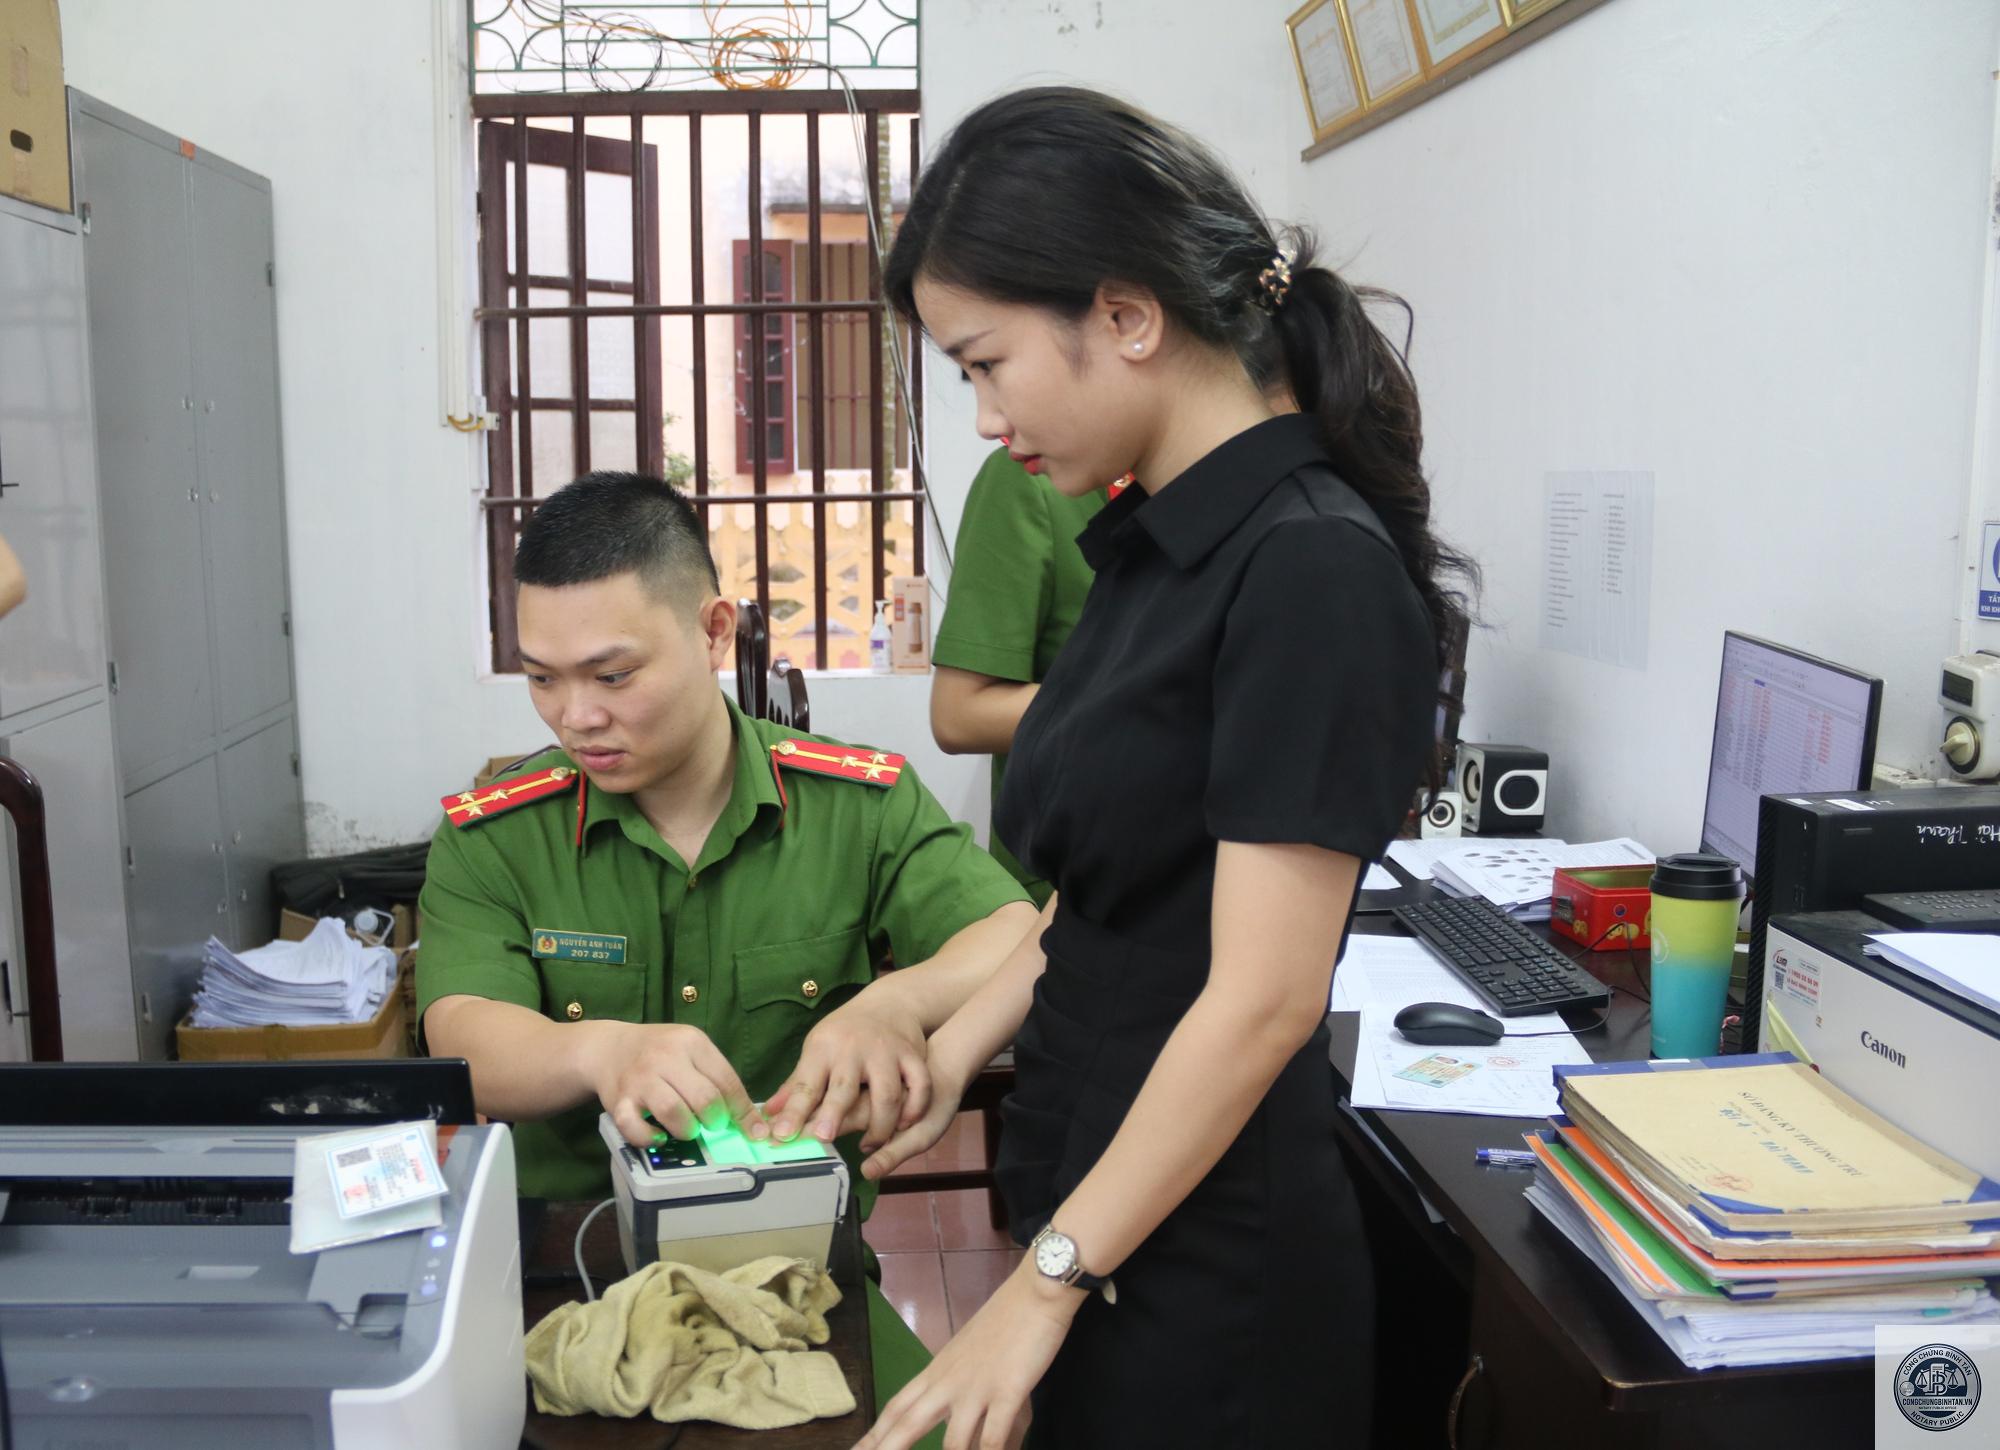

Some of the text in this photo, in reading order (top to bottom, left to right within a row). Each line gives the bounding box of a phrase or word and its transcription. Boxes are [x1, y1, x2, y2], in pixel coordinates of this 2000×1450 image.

[571, 949, 610, 960] 207 837
[1861, 1030, 1906, 1069] Canon
